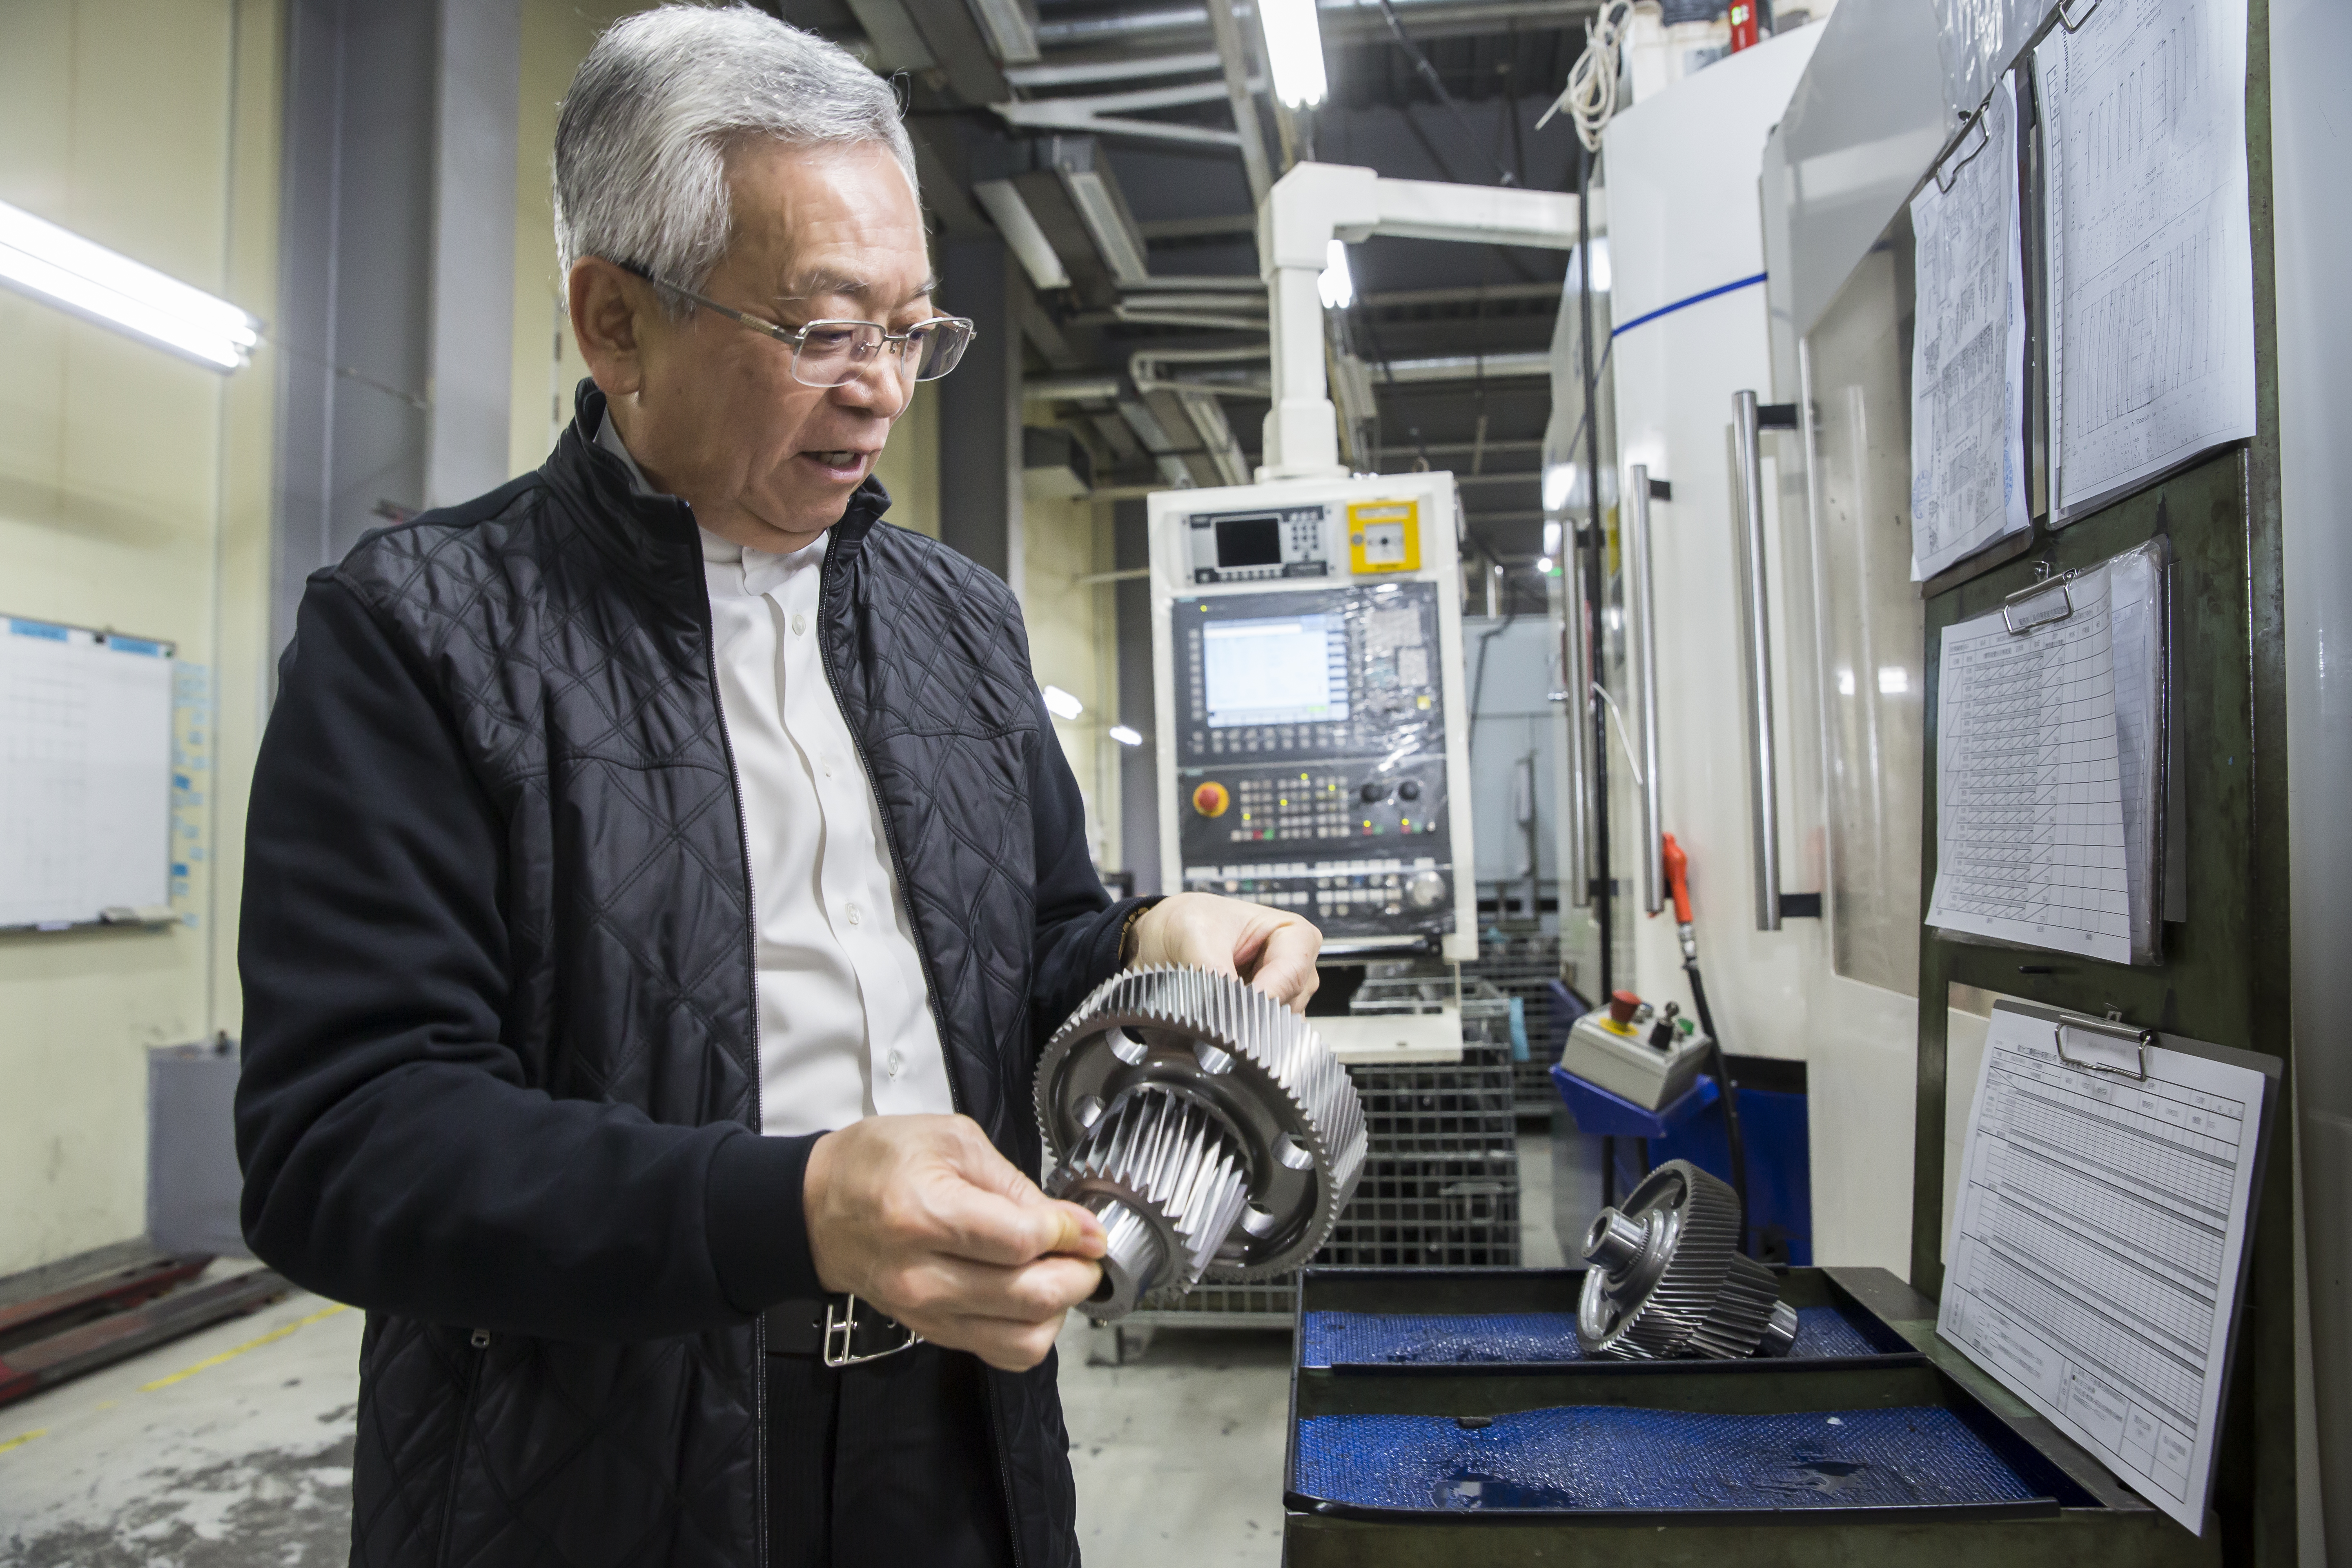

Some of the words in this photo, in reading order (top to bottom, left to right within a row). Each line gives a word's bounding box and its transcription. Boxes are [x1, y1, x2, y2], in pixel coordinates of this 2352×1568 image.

[2146, 9, 2161, 29] PROFILE
[2104, 43, 2113, 54] Plant
[2145, 167, 2156, 179] Tooth
[2141, 241, 2151, 252] LEAD
[2175, 217, 2187, 228] right
[2057, 380, 2062, 389] 11
[2057, 403, 2062, 411] 12
[2136, 414, 2149, 424] Tooth
